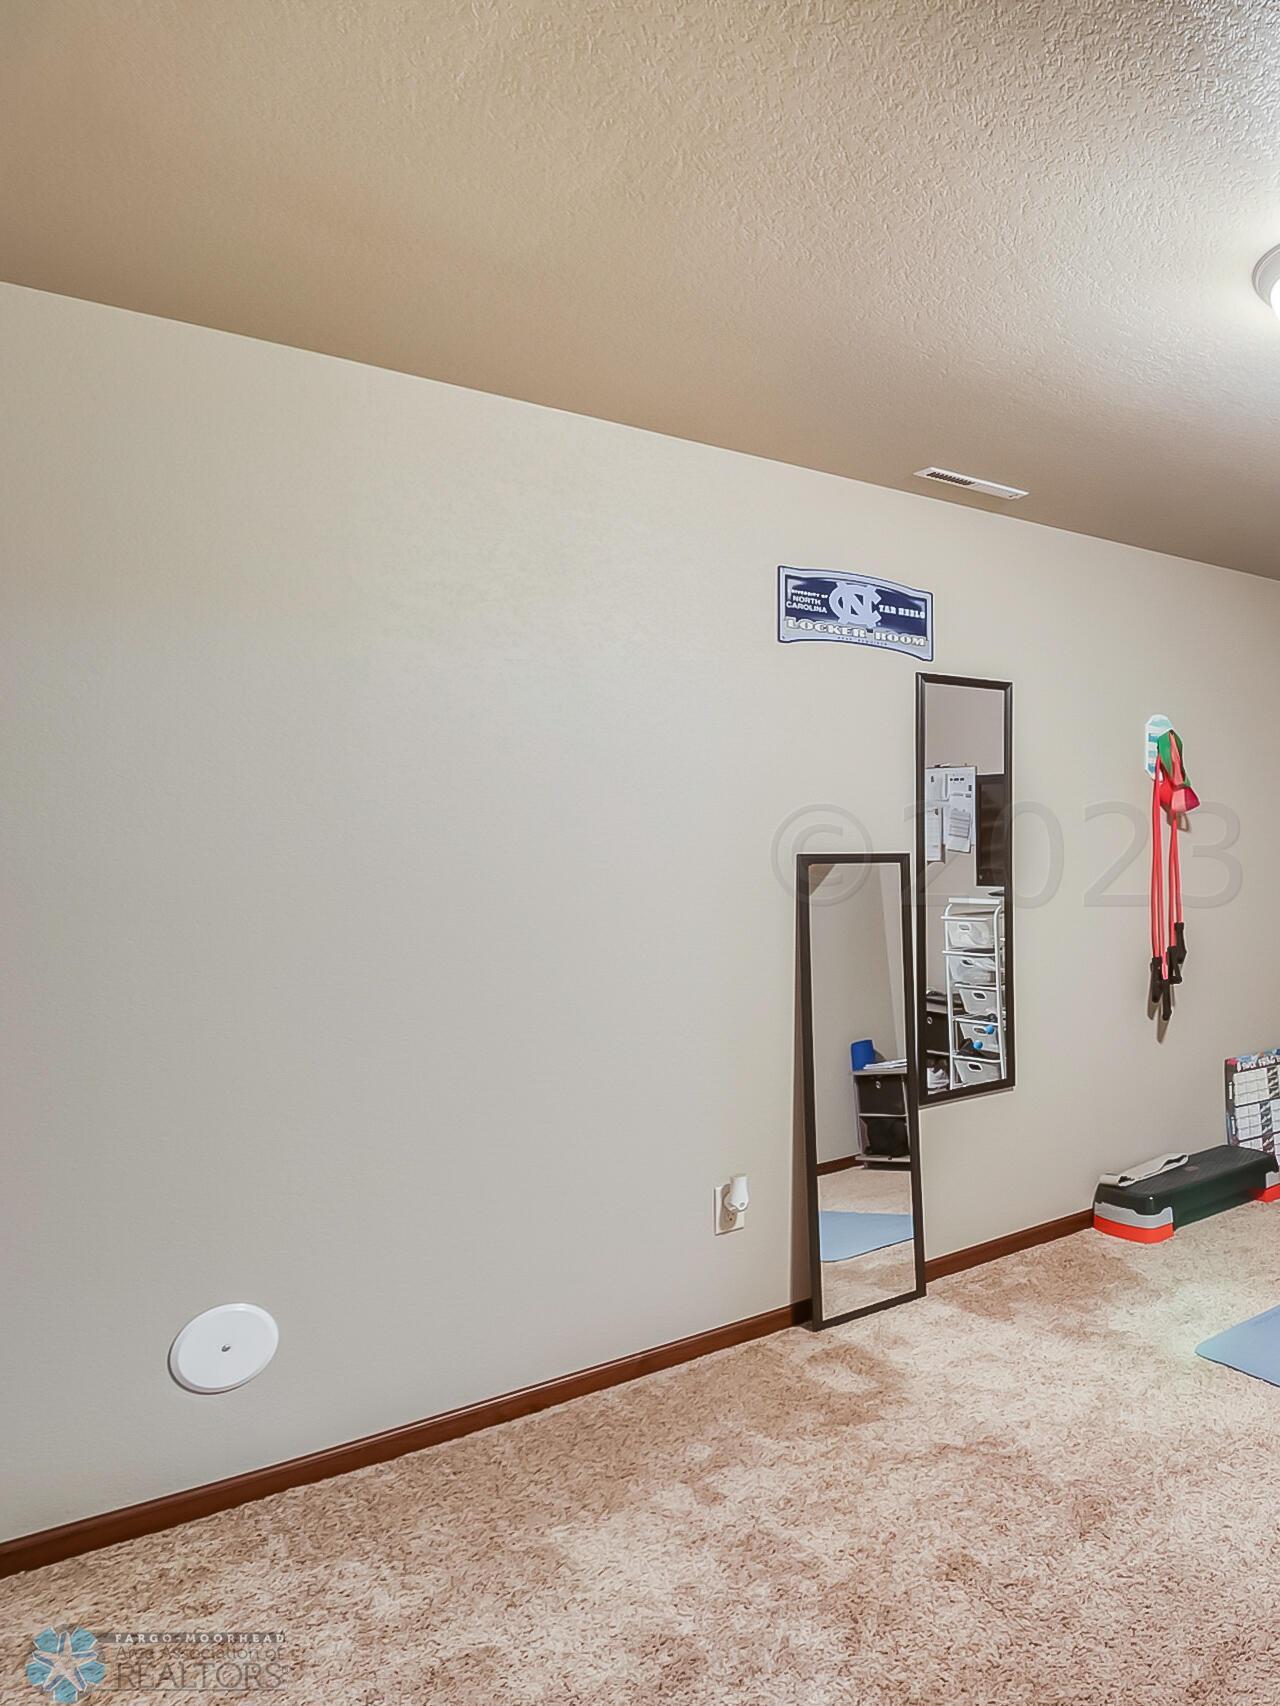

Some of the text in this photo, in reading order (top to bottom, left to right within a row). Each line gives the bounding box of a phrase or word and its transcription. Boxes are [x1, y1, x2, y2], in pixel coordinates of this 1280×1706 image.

[792, 595, 822, 606] NORTH
[785, 601, 828, 614] CAROLINA
[878, 604, 897, 615] TAR
[785, 617, 867, 639] LOCKER
[873, 630, 927, 647] ROOM
